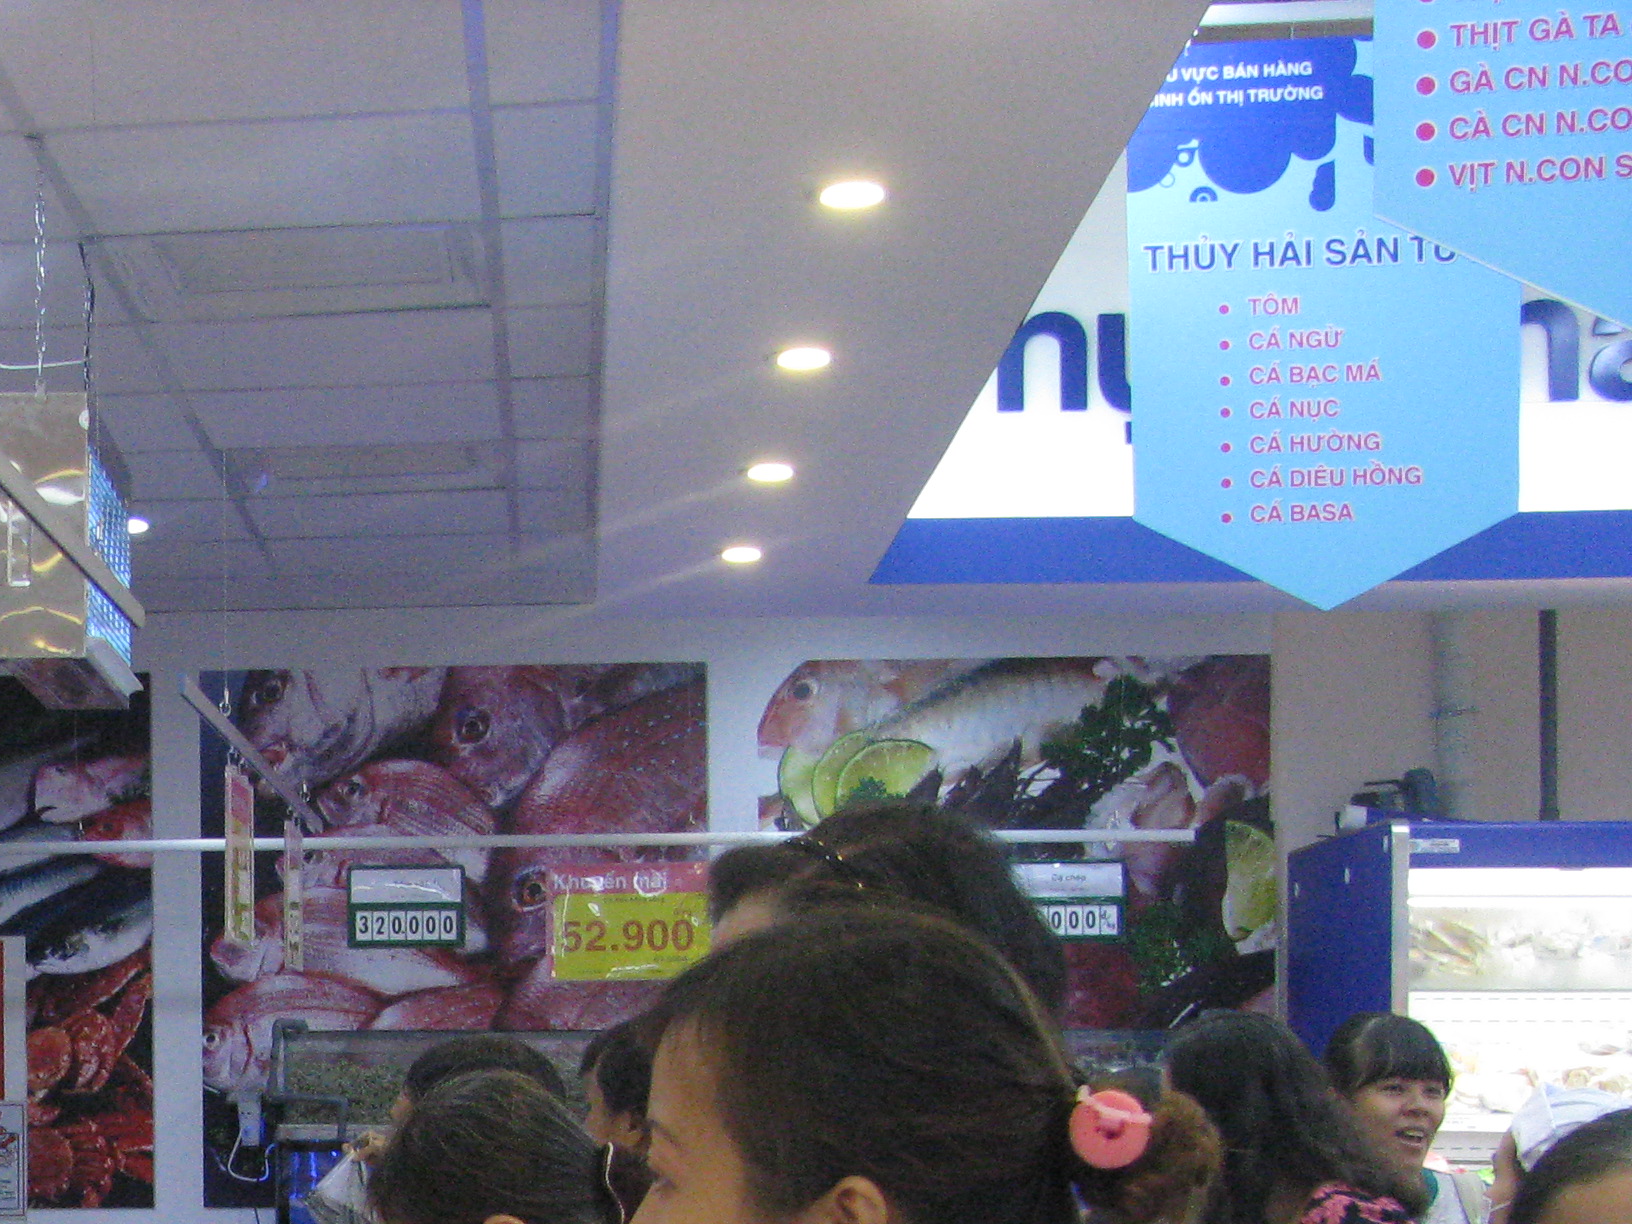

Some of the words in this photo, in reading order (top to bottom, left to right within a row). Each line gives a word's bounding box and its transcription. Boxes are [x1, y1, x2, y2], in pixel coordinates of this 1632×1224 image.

[1449, 21, 1519, 51] THỊT
[1529, 10, 1574, 41] GÀ
[1583, 13, 1620, 38] TA
[1181, 66, 1218, 84] VỰC
[1223, 61, 1258, 79] BÁN
[1263, 57, 1312, 77] HÀNG
[1449, 62, 1495, 93] GÀ
[1504, 65, 1548, 90] CN
[1216, 89, 1244, 107] THỊ
[1247, 84, 1323, 103] TRƯỜNG
[1501, 113, 1545, 137] CN
[1448, 161, 1496, 191] VỊT
[1505, 156, 1604, 183] N.CON
[1143, 235, 1240, 272] THỦY
[1252, 231, 1313, 268] HẢI
[1325, 229, 1399, 265] SẢN
[1248, 293, 1300, 316] TÔM
[1248, 325, 1281, 351] CÁ
[1288, 324, 1344, 349] NGỪ
[1248, 359, 1282, 385] CÁ
[1289, 364, 1338, 388] BẠC
[1346, 358, 1381, 382] MÁ
[1249, 395, 1282, 419] CÁ
[1289, 399, 1339, 422] NỤC
[1249, 429, 1282, 453] CÁ
[1289, 428, 1381, 452] HƯỜNG
[1249, 464, 1283, 488] CÁ
[1352, 459, 1422, 485] HỒNG
[1249, 498, 1283, 522] CÁ
[1290, 503, 1354, 522] BASA
[564, 919, 694, 952] 52.900
